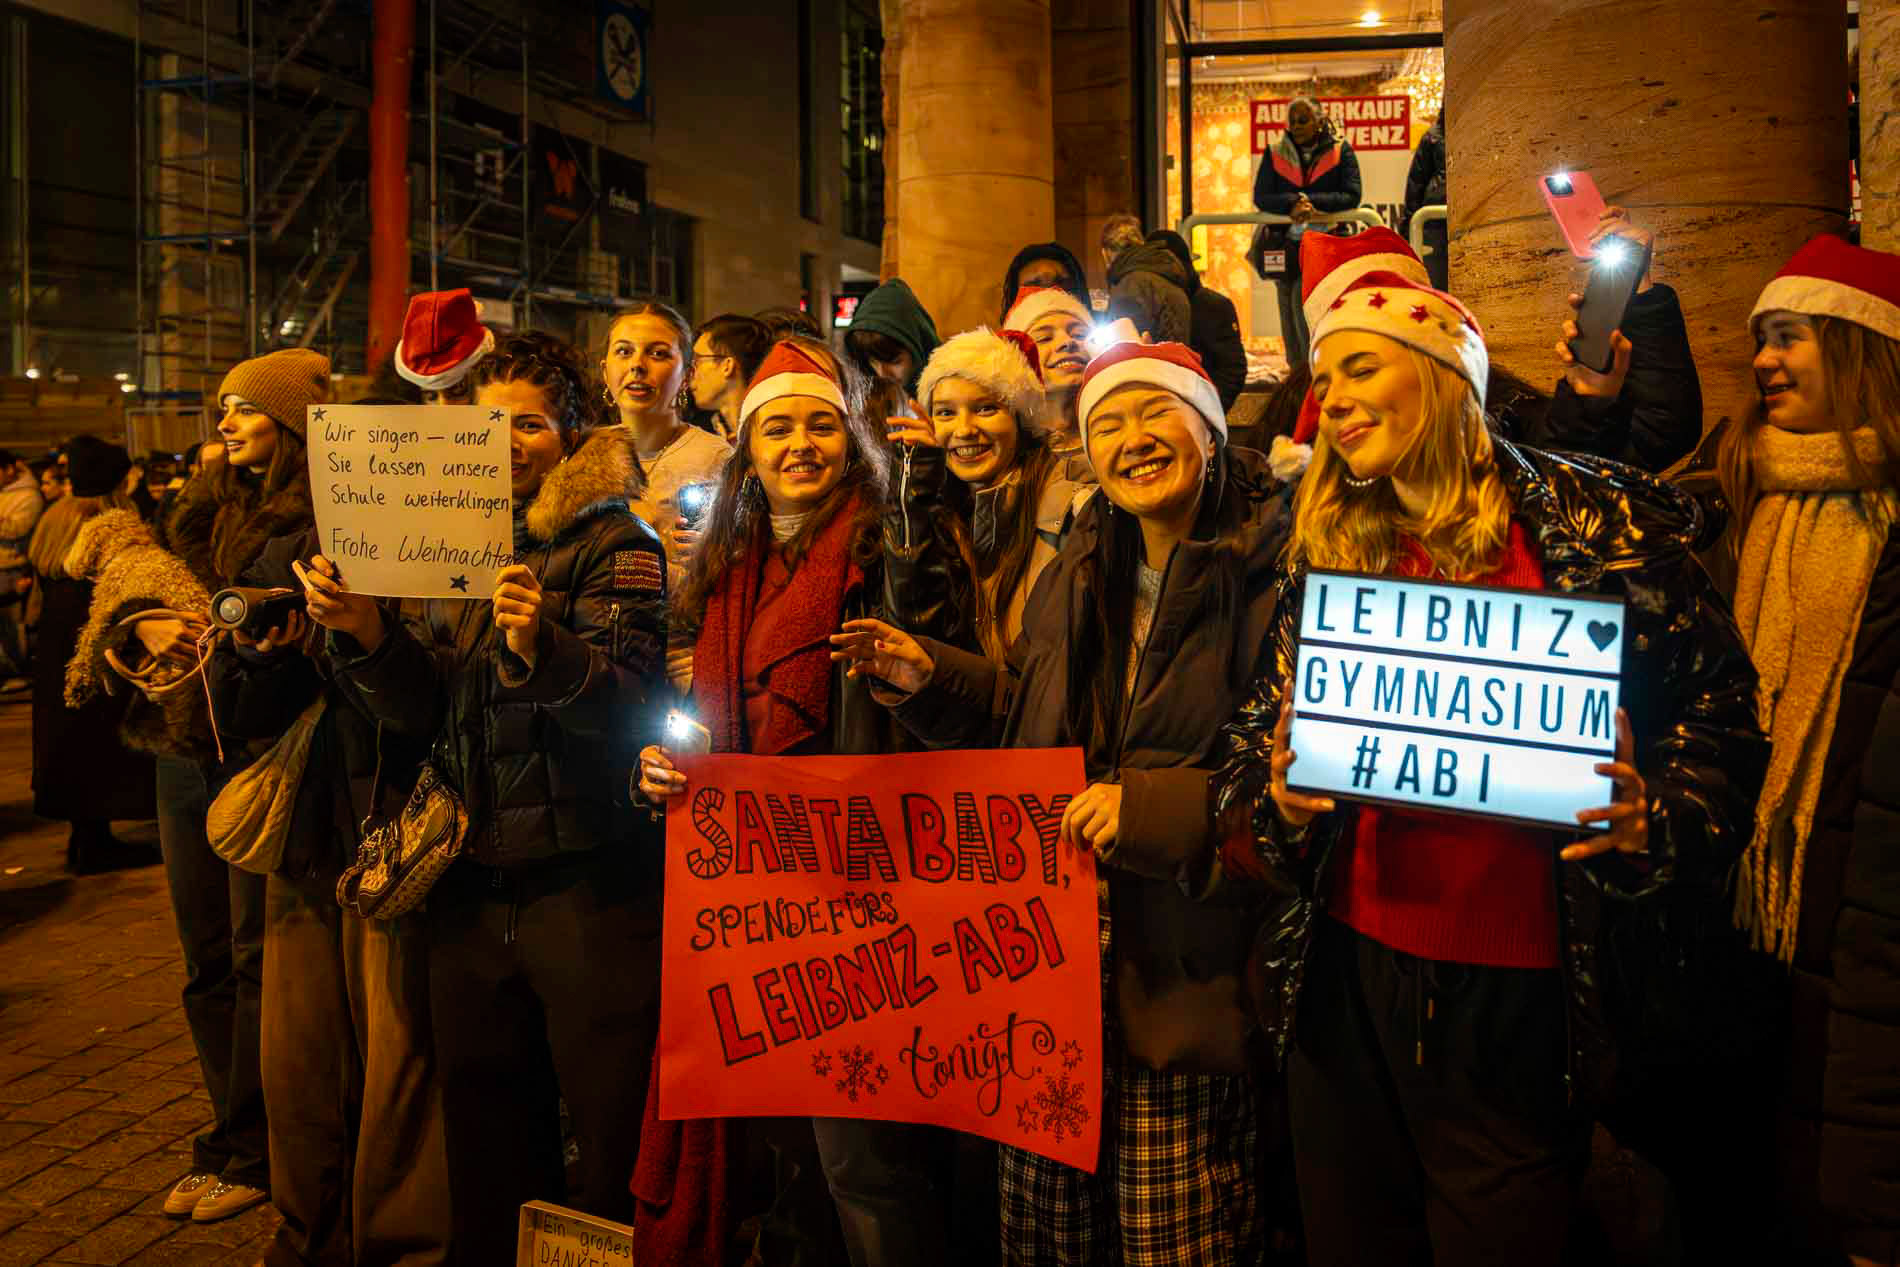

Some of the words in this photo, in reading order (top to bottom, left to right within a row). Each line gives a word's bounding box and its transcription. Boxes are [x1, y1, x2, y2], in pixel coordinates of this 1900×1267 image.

[1256, 100, 1405, 124] AUERKAUF
[1256, 125, 1405, 149] INVENZ
[325, 422, 356, 442] Wir
[368, 424, 419, 453] singen
[454, 427, 491, 447] und
[328, 451, 352, 473] Sie
[369, 454, 425, 477] lassen
[442, 462, 499, 479] unsere
[330, 483, 385, 505] Schule
[404, 489, 510, 519] weiterklingen
[332, 527, 380, 560] Frohe
[1317, 584, 1574, 658] LEIBNIZ
[1304, 656, 1611, 740] GYMNASIUM
[1352, 734, 1491, 804] #ABI
[686, 786, 899, 884] SANTA
[901, 791, 1073, 889] BABY,
[543, 1214, 566, 1238] Ein
[580, 1231, 631, 1260] großes
